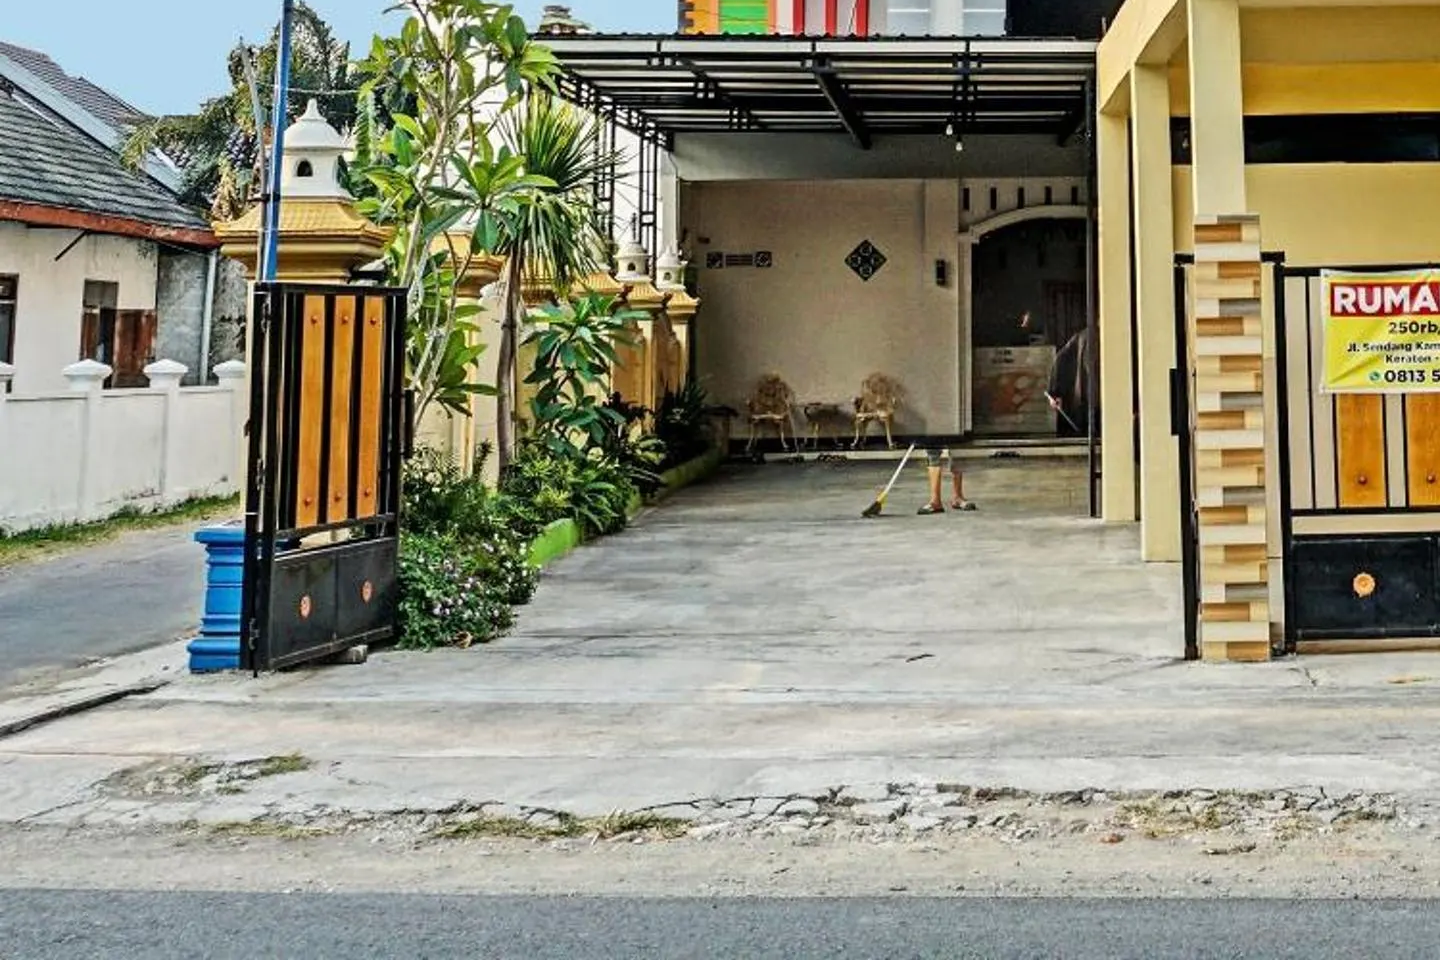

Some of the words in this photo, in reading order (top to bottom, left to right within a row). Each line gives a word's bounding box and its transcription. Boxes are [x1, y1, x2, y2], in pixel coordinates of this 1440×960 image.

[1347, 343, 1360, 352] Jl.
[1363, 342, 1412, 352] Sendang
[1386, 355, 1431, 363] Keraton
[1384, 369, 1425, 383] 0813
